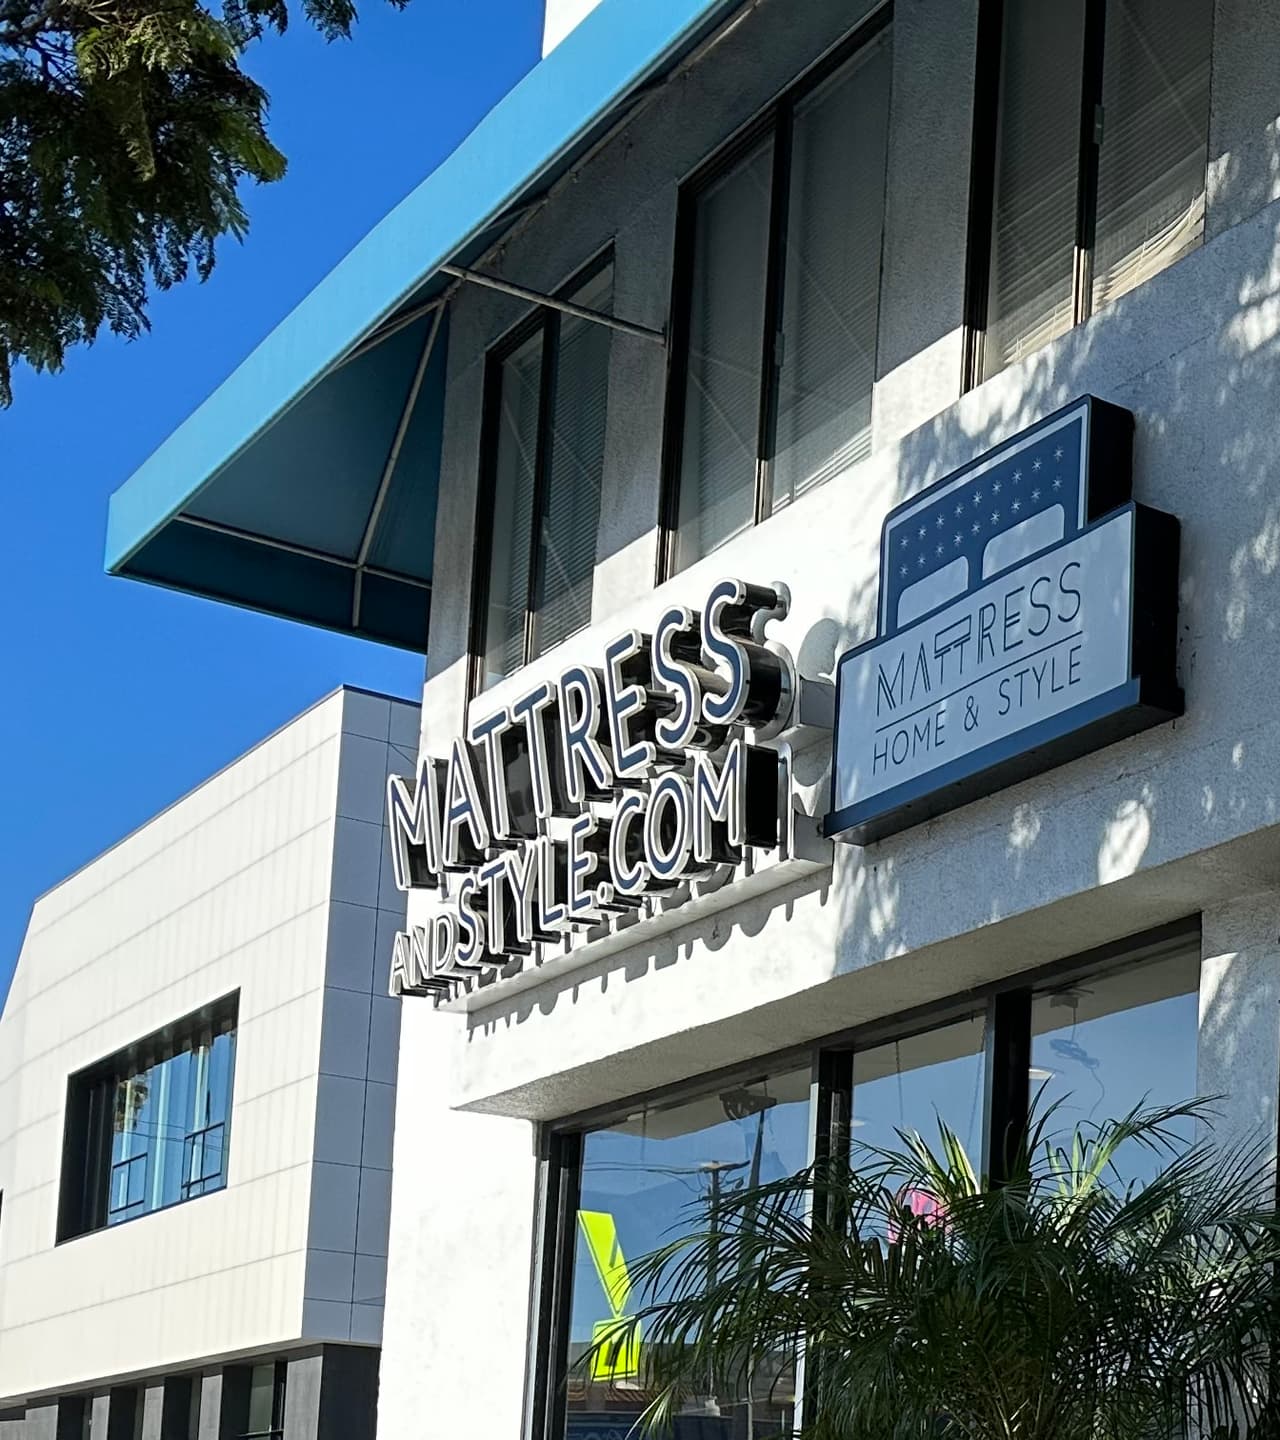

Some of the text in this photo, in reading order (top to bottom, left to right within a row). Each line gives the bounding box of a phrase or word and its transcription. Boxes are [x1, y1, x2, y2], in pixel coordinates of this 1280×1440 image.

[872, 645, 1082, 776] HOME & STYLE
[876, 561, 1082, 717] MATTRESS
[388, 577, 750, 890] MATTRESS
